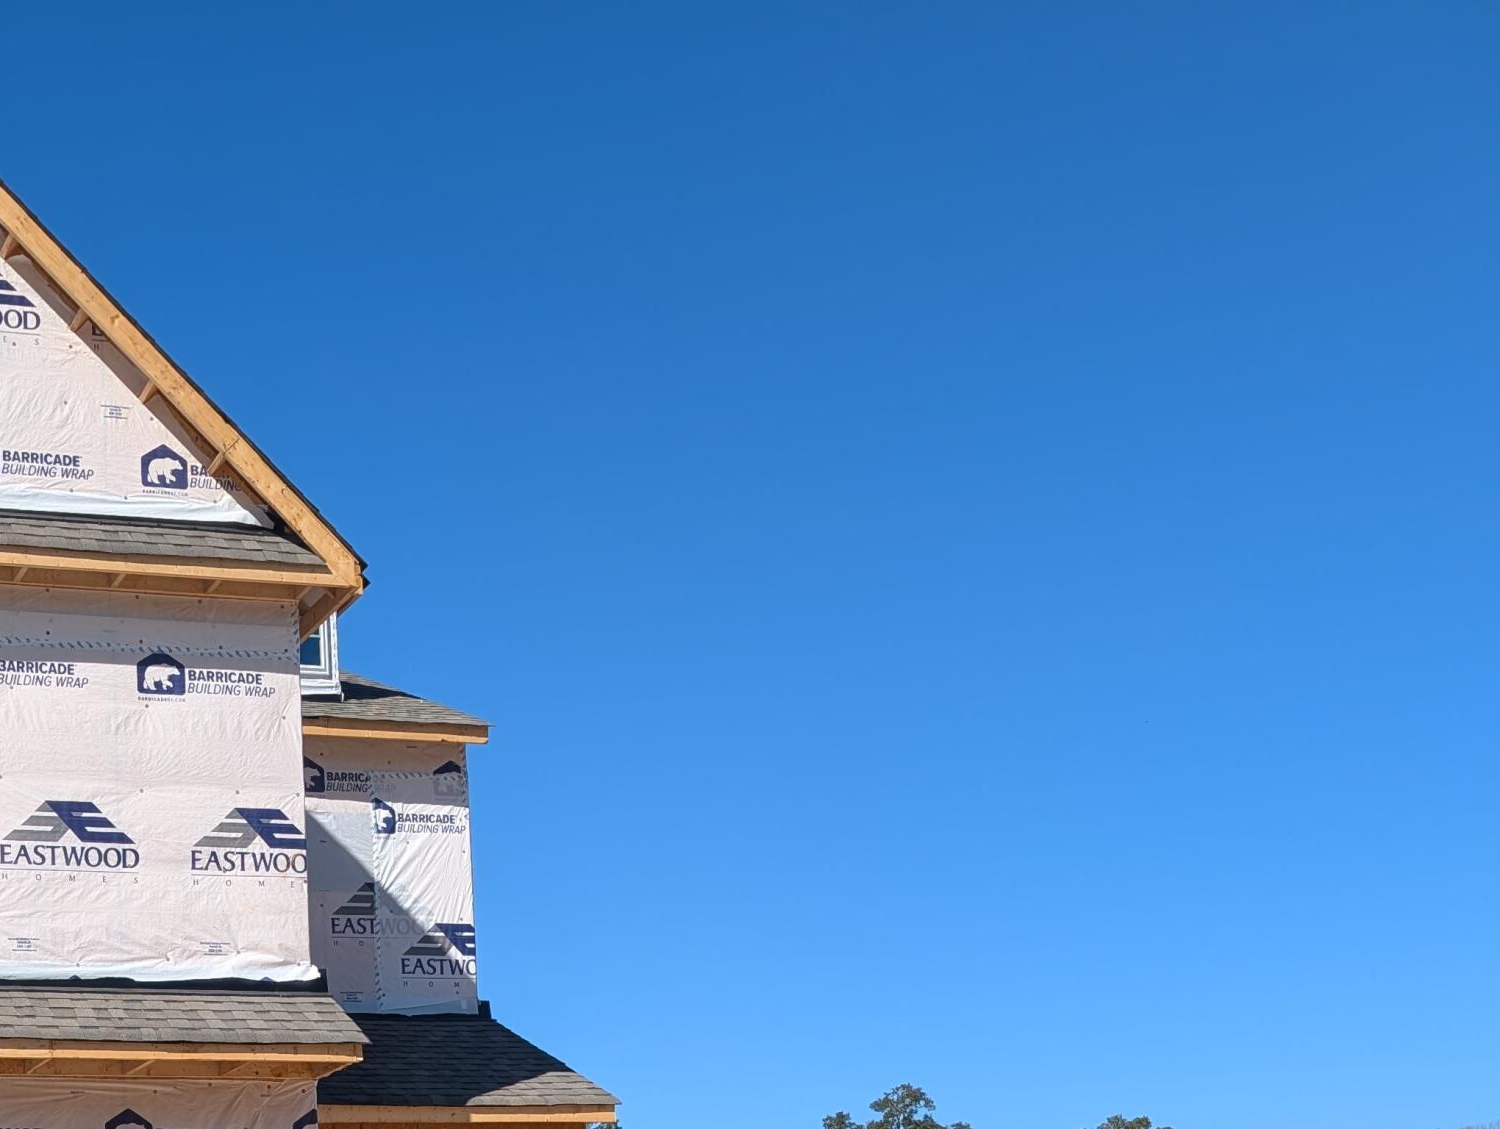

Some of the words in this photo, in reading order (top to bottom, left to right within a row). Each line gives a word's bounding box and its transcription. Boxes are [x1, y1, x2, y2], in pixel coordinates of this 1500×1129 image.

[2, 450, 80, 468] BARRICADE
[1, 463, 58, 478] BUILDING
[60, 467, 94, 480] WRAP
[56, 676, 89, 689] WRAP
[188, 670, 263, 686] BARRICADE
[187, 682, 242, 696] BUILDING
[244, 686, 276, 699] WRAP
[326, 782, 368, 792] BUILDING
[397, 813, 455, 824] BARRICADE
[397, 824, 439, 834] BUILDING
[441, 824, 466, 834] WRAP
[0, 844, 140, 869] EASTWOOD
[191, 850, 307, 874] EASTWOO
[2, 872, 139, 885] HOMES
[193, 878, 296, 888] HOME
[401, 958, 476, 976] EASTWO
